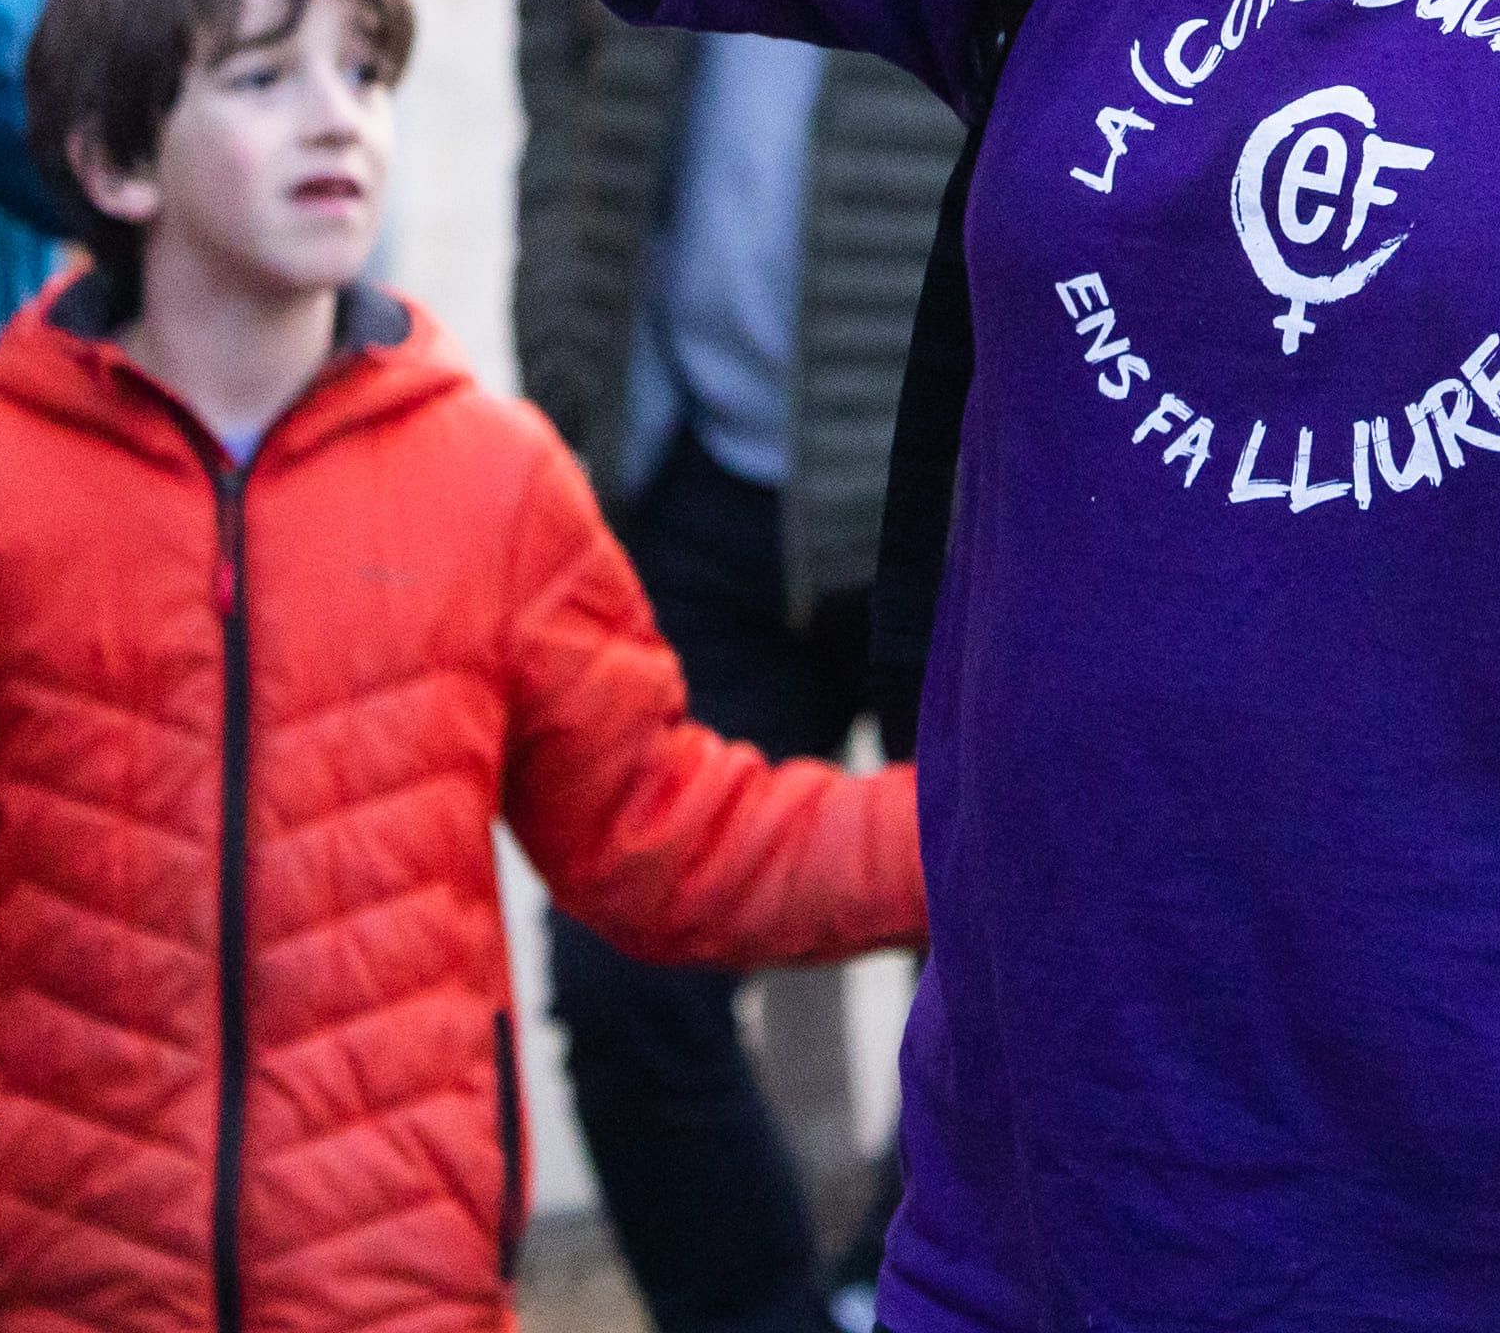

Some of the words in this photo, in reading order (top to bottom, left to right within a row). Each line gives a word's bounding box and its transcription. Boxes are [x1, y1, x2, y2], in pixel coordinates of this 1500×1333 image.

[1070, 106, 1154, 193] LA
[1055, 272, 1150, 400] ENS
[1132, 392, 1213, 488] FA
